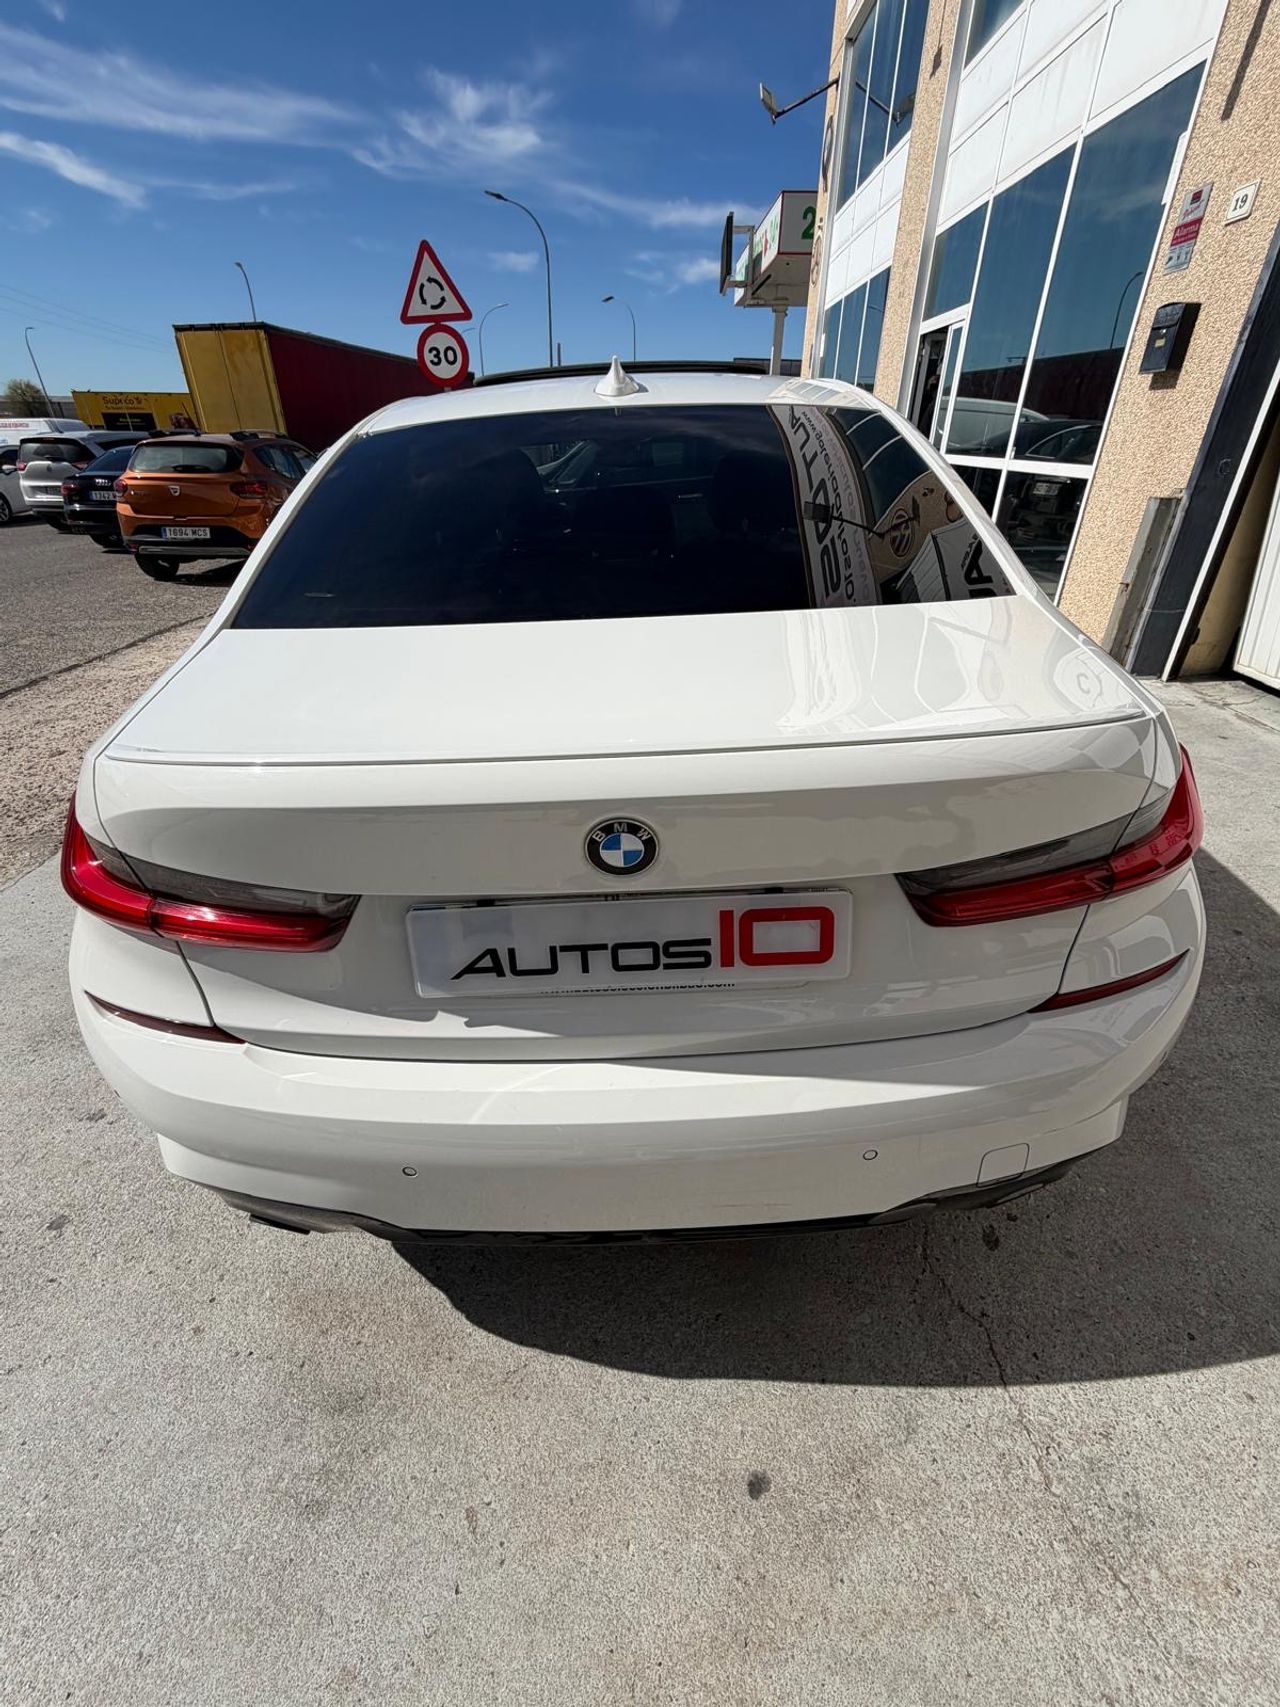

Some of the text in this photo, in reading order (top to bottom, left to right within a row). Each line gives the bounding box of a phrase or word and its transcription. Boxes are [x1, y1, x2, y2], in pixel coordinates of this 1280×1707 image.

[1232, 194, 1248, 212] 19
[428, 346, 458, 366] 30
[168, 527, 208, 537] 1694 MCS
[592, 822, 651, 842] BMW
